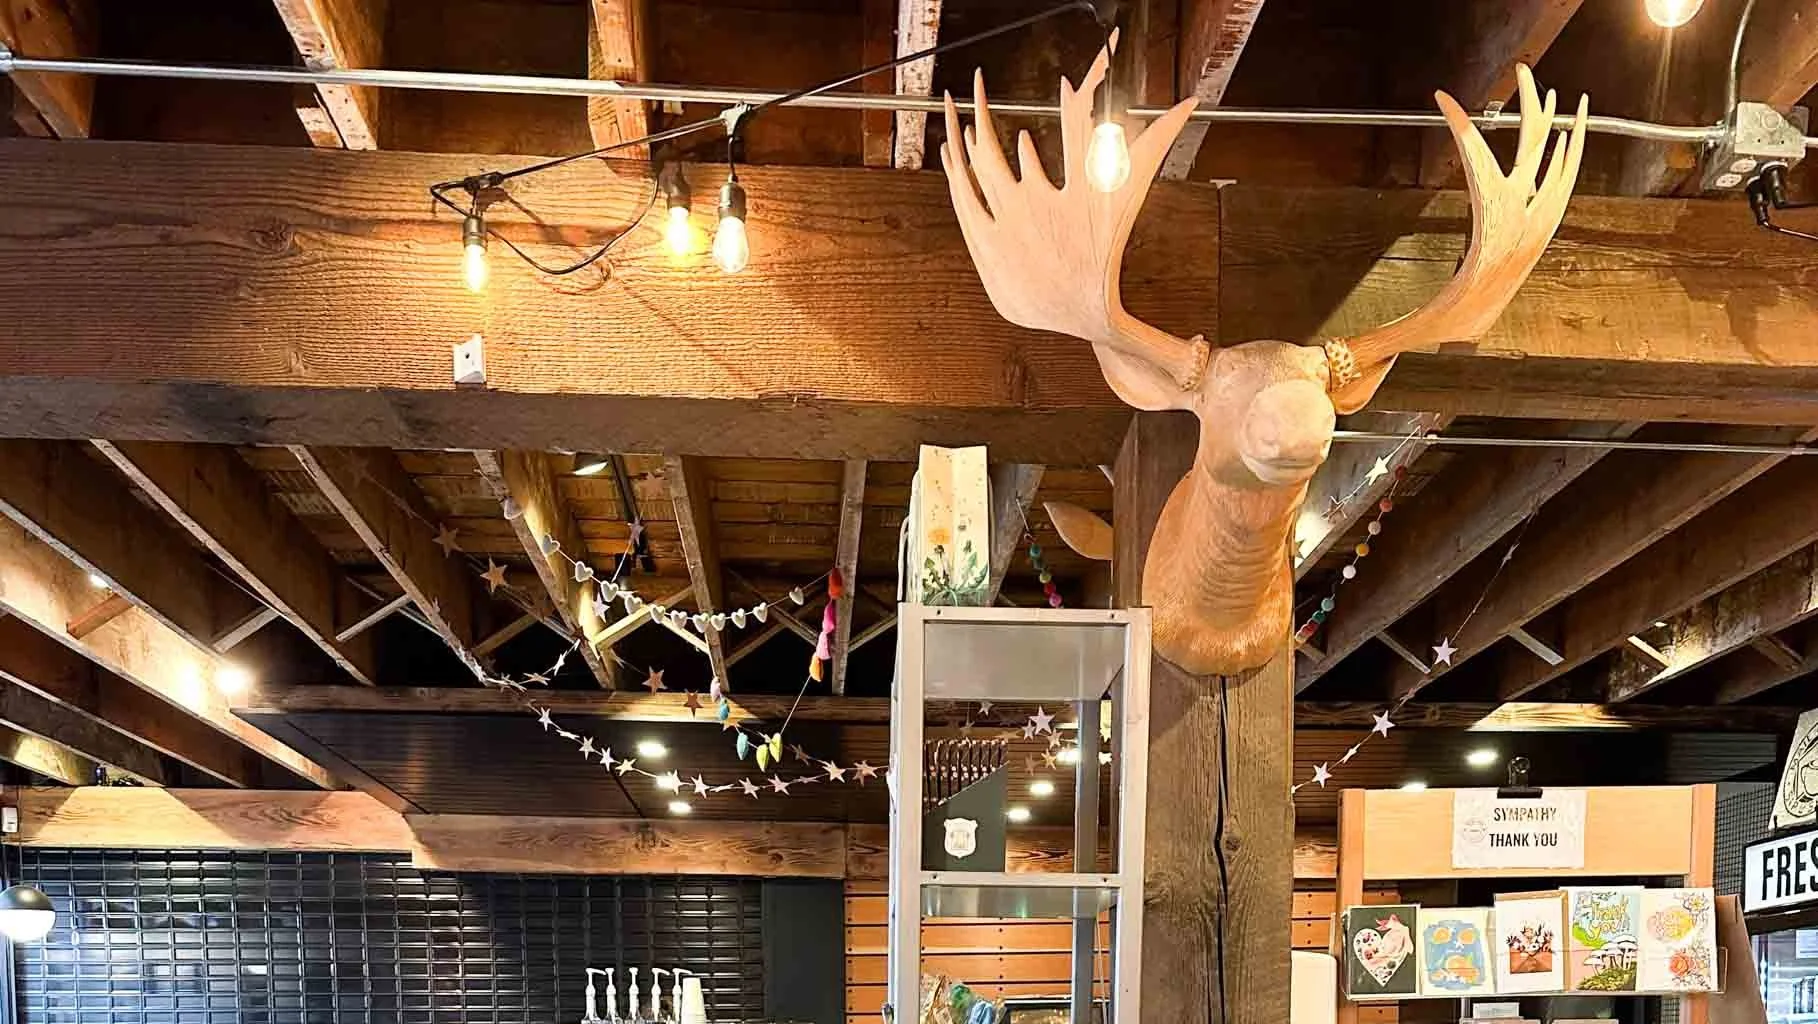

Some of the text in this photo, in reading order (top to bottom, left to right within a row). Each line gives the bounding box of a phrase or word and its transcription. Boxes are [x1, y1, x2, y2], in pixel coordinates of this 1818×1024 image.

[1493, 807, 1557, 821] SYMPATHY
[1489, 832, 1557, 847] THANK YOU
